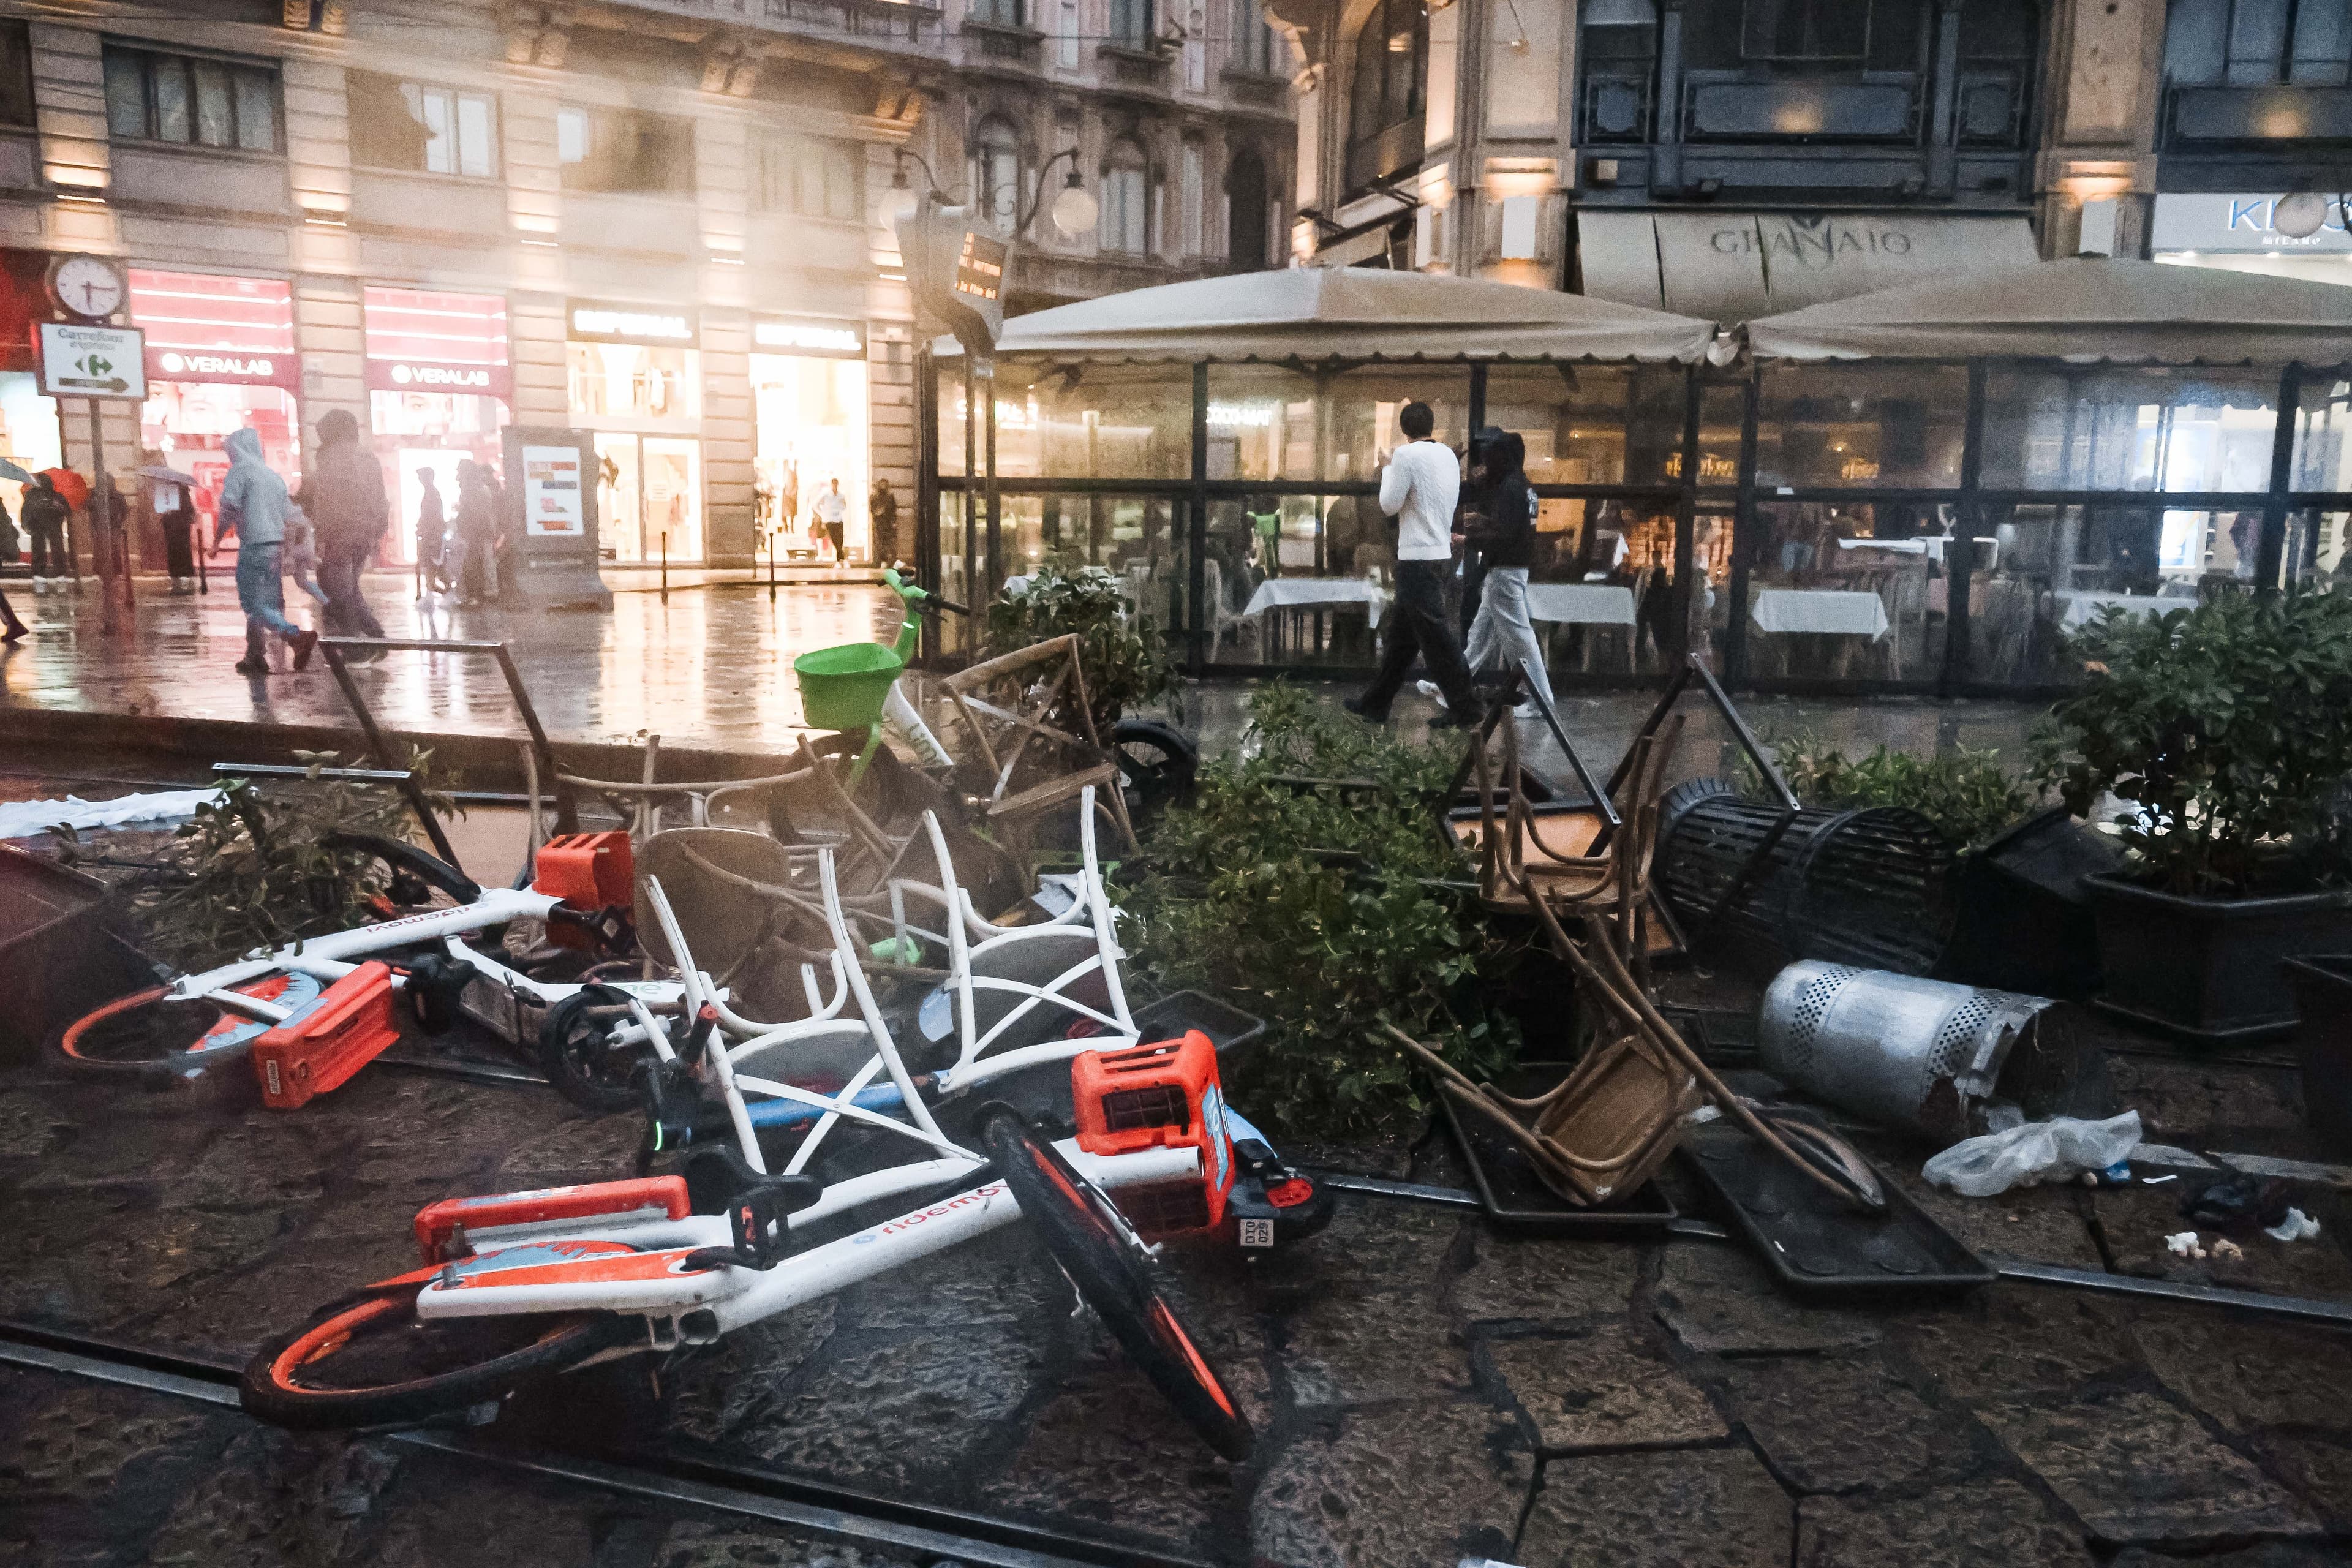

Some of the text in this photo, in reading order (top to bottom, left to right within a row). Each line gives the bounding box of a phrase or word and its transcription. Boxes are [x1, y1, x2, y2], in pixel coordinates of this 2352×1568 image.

[2224, 199, 2352, 232] KIO
[184, 355, 274, 375] VERALAB
[412, 367, 489, 386] VERALAB
[1258, 1223, 1268, 1243] 029
